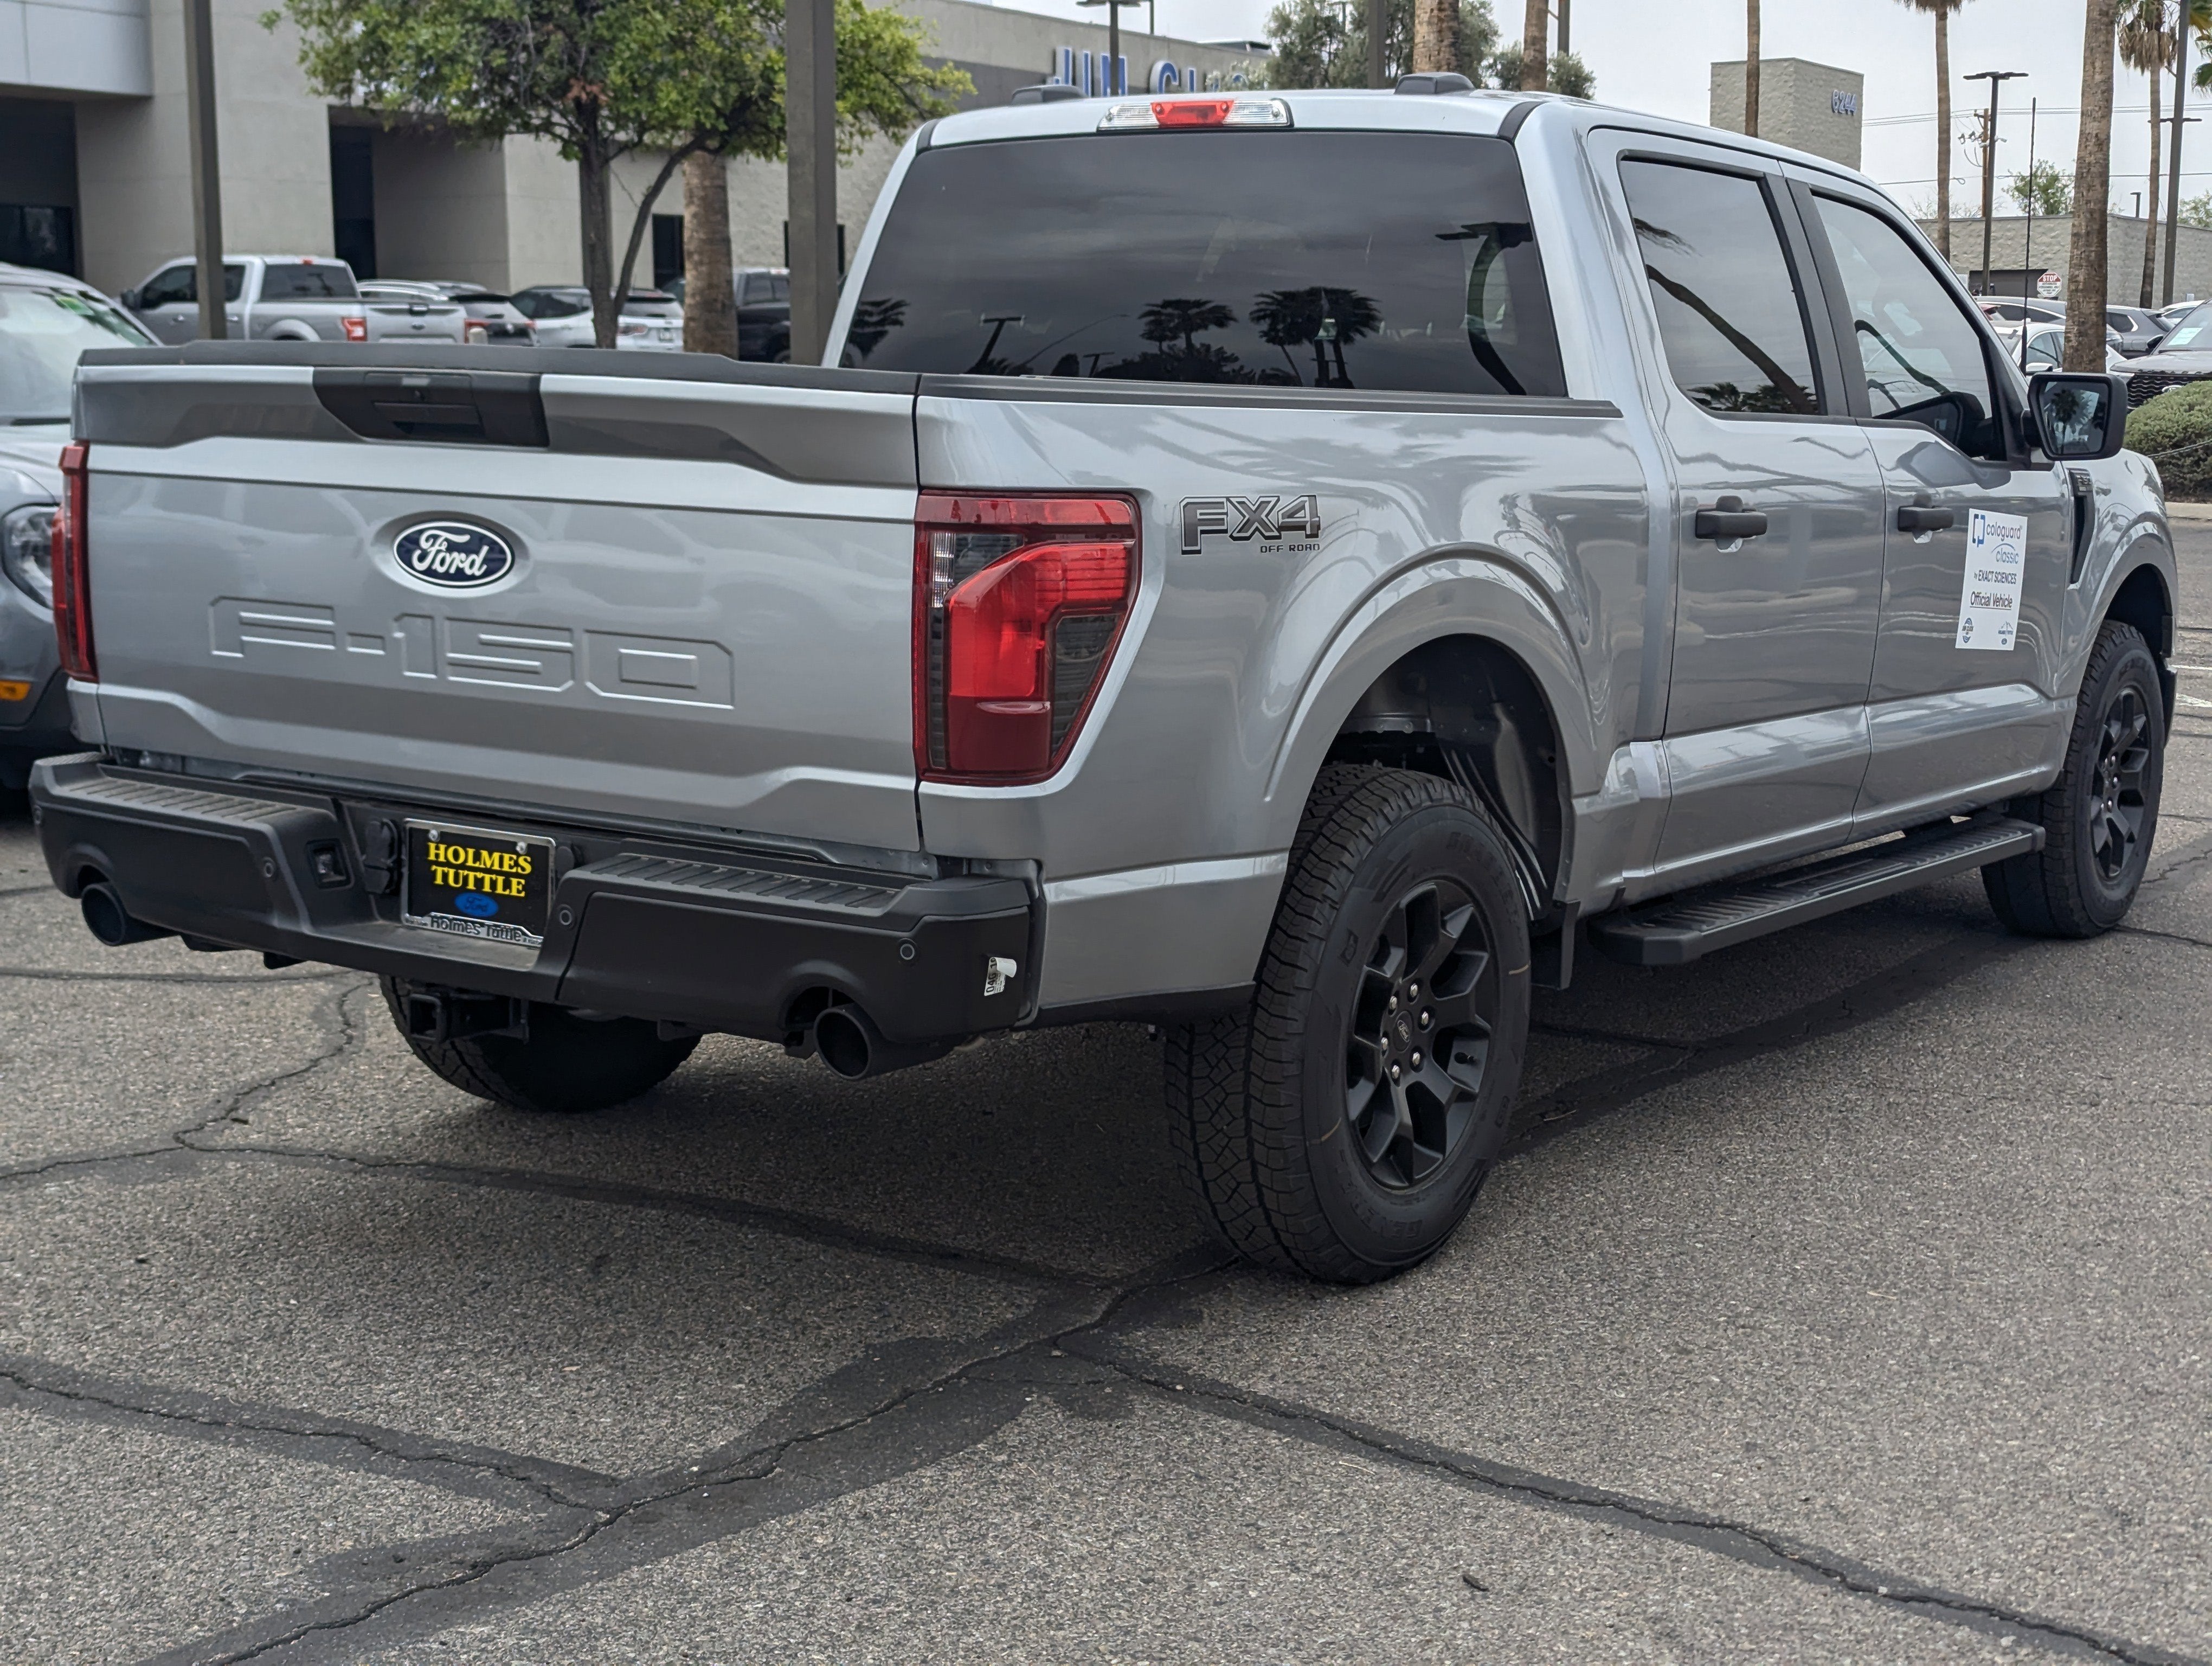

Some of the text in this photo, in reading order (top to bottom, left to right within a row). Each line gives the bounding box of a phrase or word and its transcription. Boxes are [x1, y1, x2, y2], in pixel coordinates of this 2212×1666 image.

[1179, 495, 1321, 555] FX4
[1986, 521, 2021, 541] cologuard
[410, 529, 488, 578] Ford
[1260, 543, 1321, 553] OFF ROAD
[1996, 548, 2019, 564] classic
[1978, 569, 1994, 582] EXACT
[1994, 571, 2017, 584] SCIENCES
[1970, 591, 2013, 608] Official Vehicle
[209, 595, 735, 710] F-150
[427, 842, 532, 874] HOLMES
[430, 864, 526, 898] TUTTLE
[430, 915, 481, 935] Holmes
[485, 924, 523, 943] Tuttle
